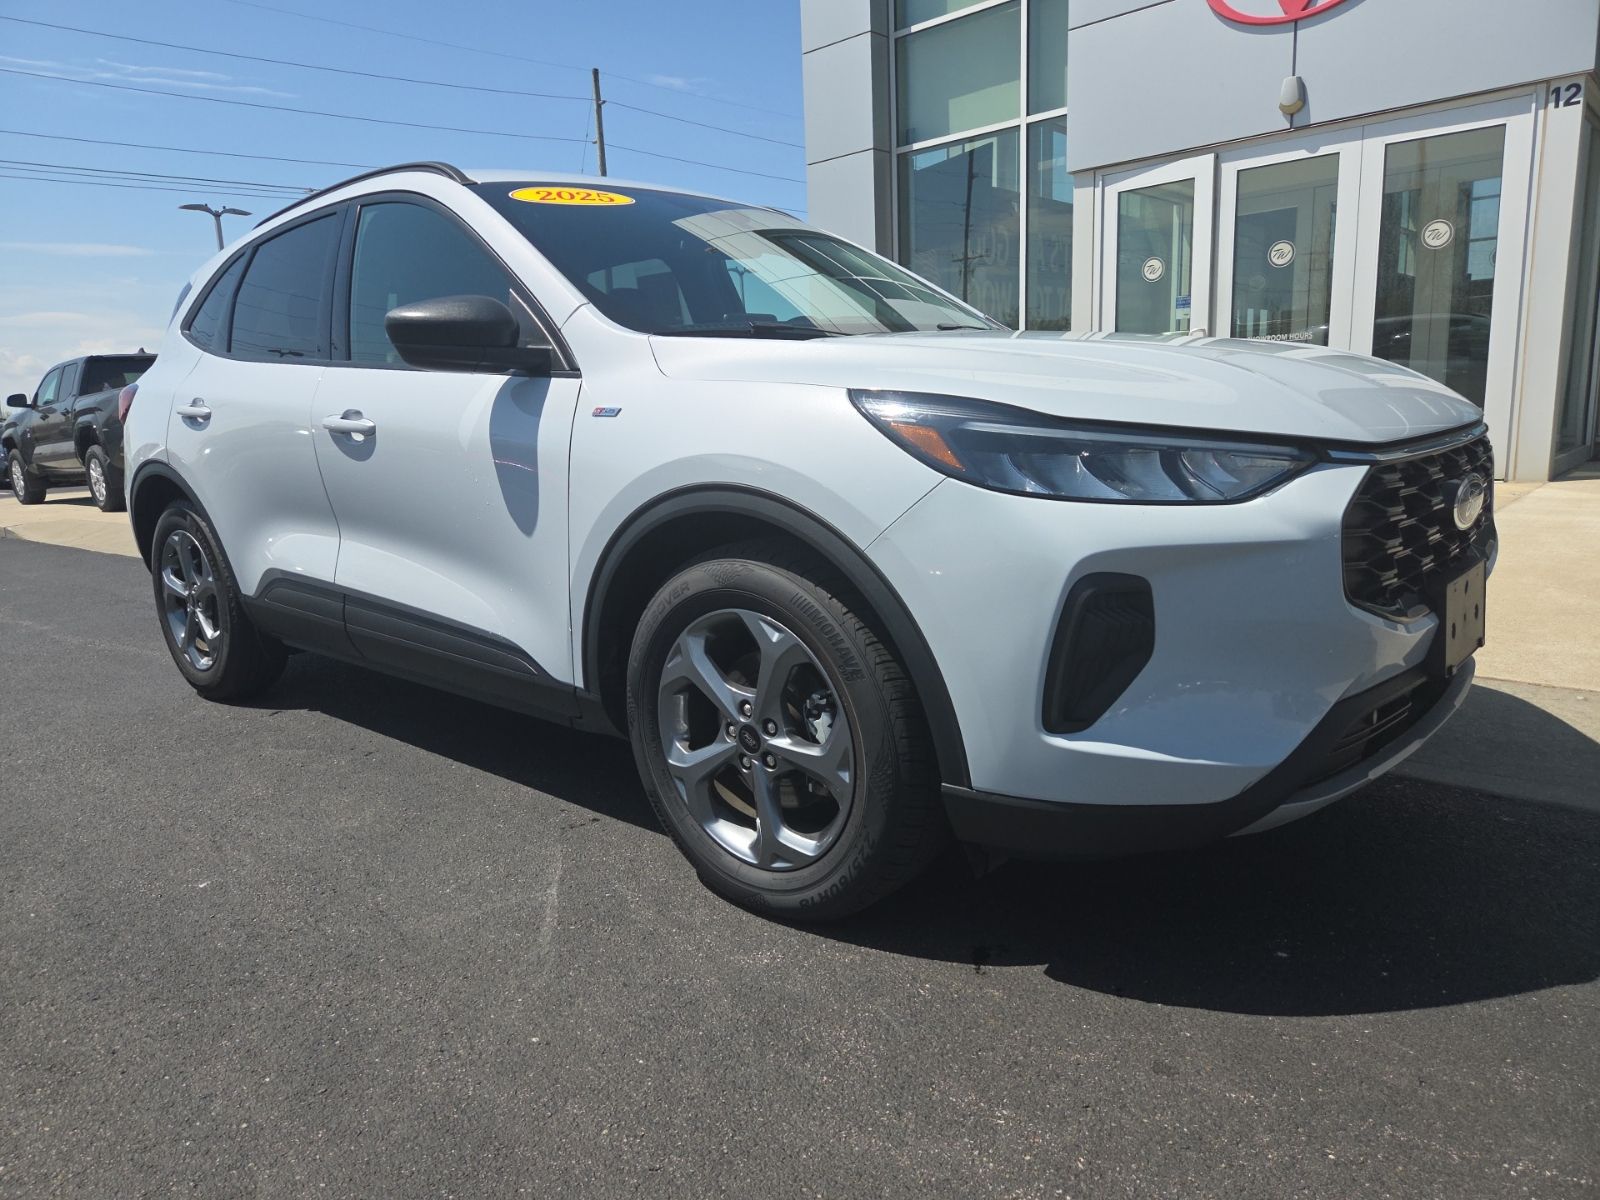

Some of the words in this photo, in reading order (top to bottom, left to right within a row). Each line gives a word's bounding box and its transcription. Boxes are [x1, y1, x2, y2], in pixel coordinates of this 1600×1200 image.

[1550, 83, 1582, 109] 12
[535, 190, 615, 203] 2025
[1289, 331, 1313, 340] HOURS
